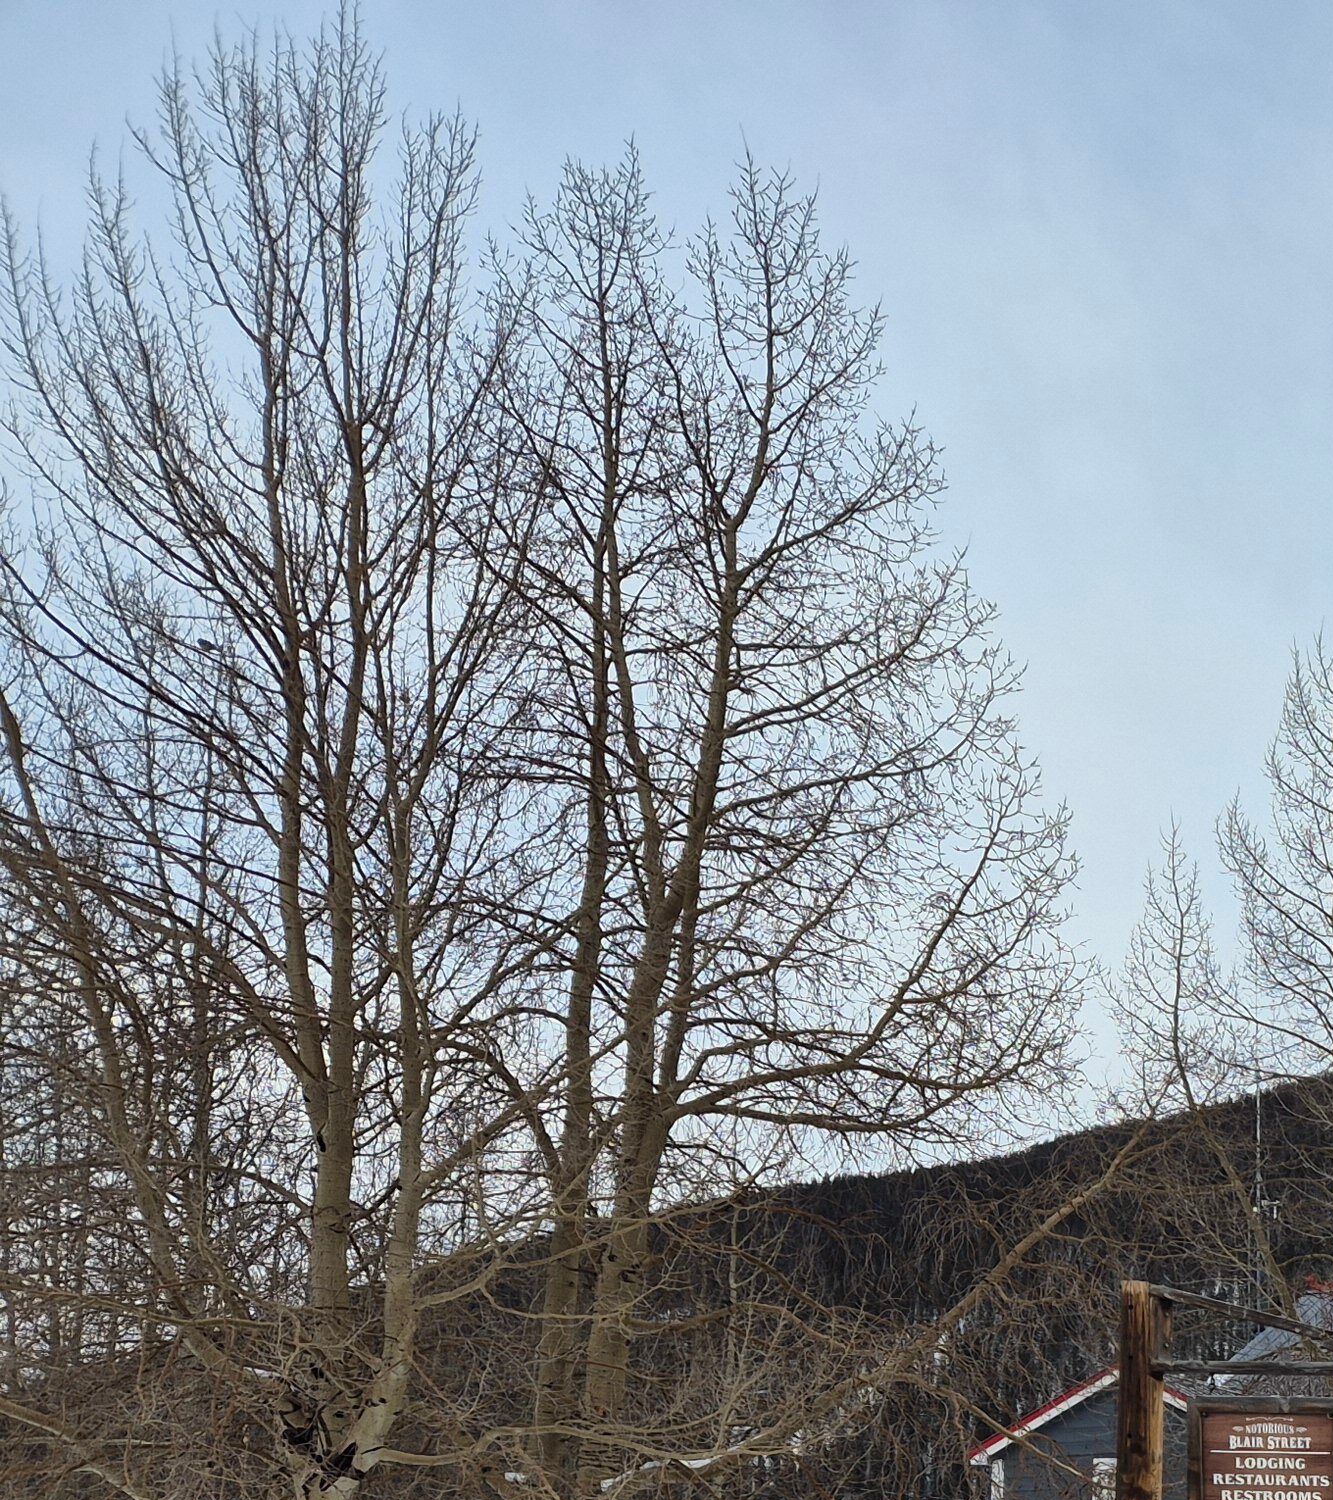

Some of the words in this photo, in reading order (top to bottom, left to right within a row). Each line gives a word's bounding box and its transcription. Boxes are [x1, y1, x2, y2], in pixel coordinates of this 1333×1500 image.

[1246, 1423, 1294, 1434] NOTORIOUS
[1229, 1435, 1264, 1449] BLAIR
[1267, 1436, 1312, 1450] STREET
[1235, 1457, 1306, 1470] LODGING
[1213, 1473, 1330, 1487] RESTAURANTS
